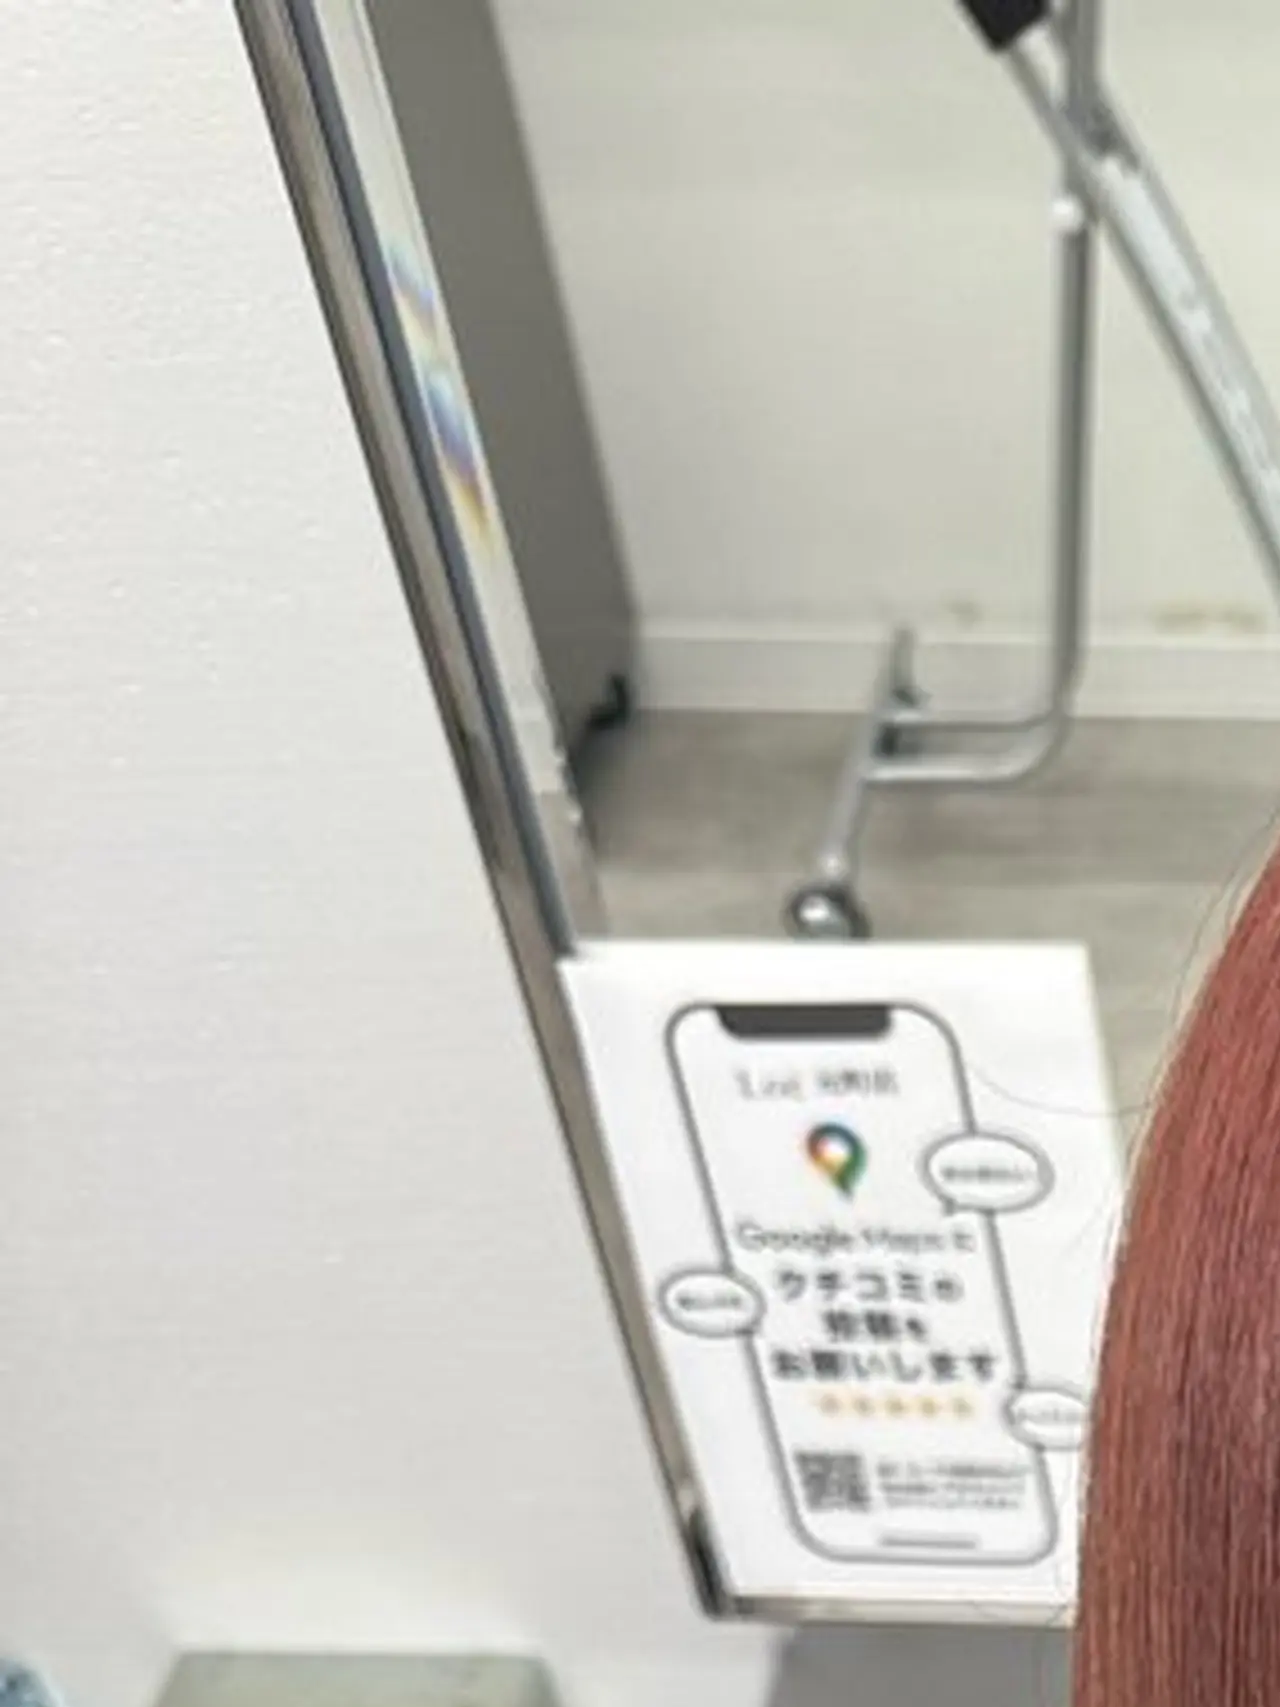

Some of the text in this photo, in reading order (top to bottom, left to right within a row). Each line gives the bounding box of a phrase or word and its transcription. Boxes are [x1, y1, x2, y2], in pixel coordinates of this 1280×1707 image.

[738, 1223, 853, 1255] Google
[777, 1268, 964, 1303] クチコミの
